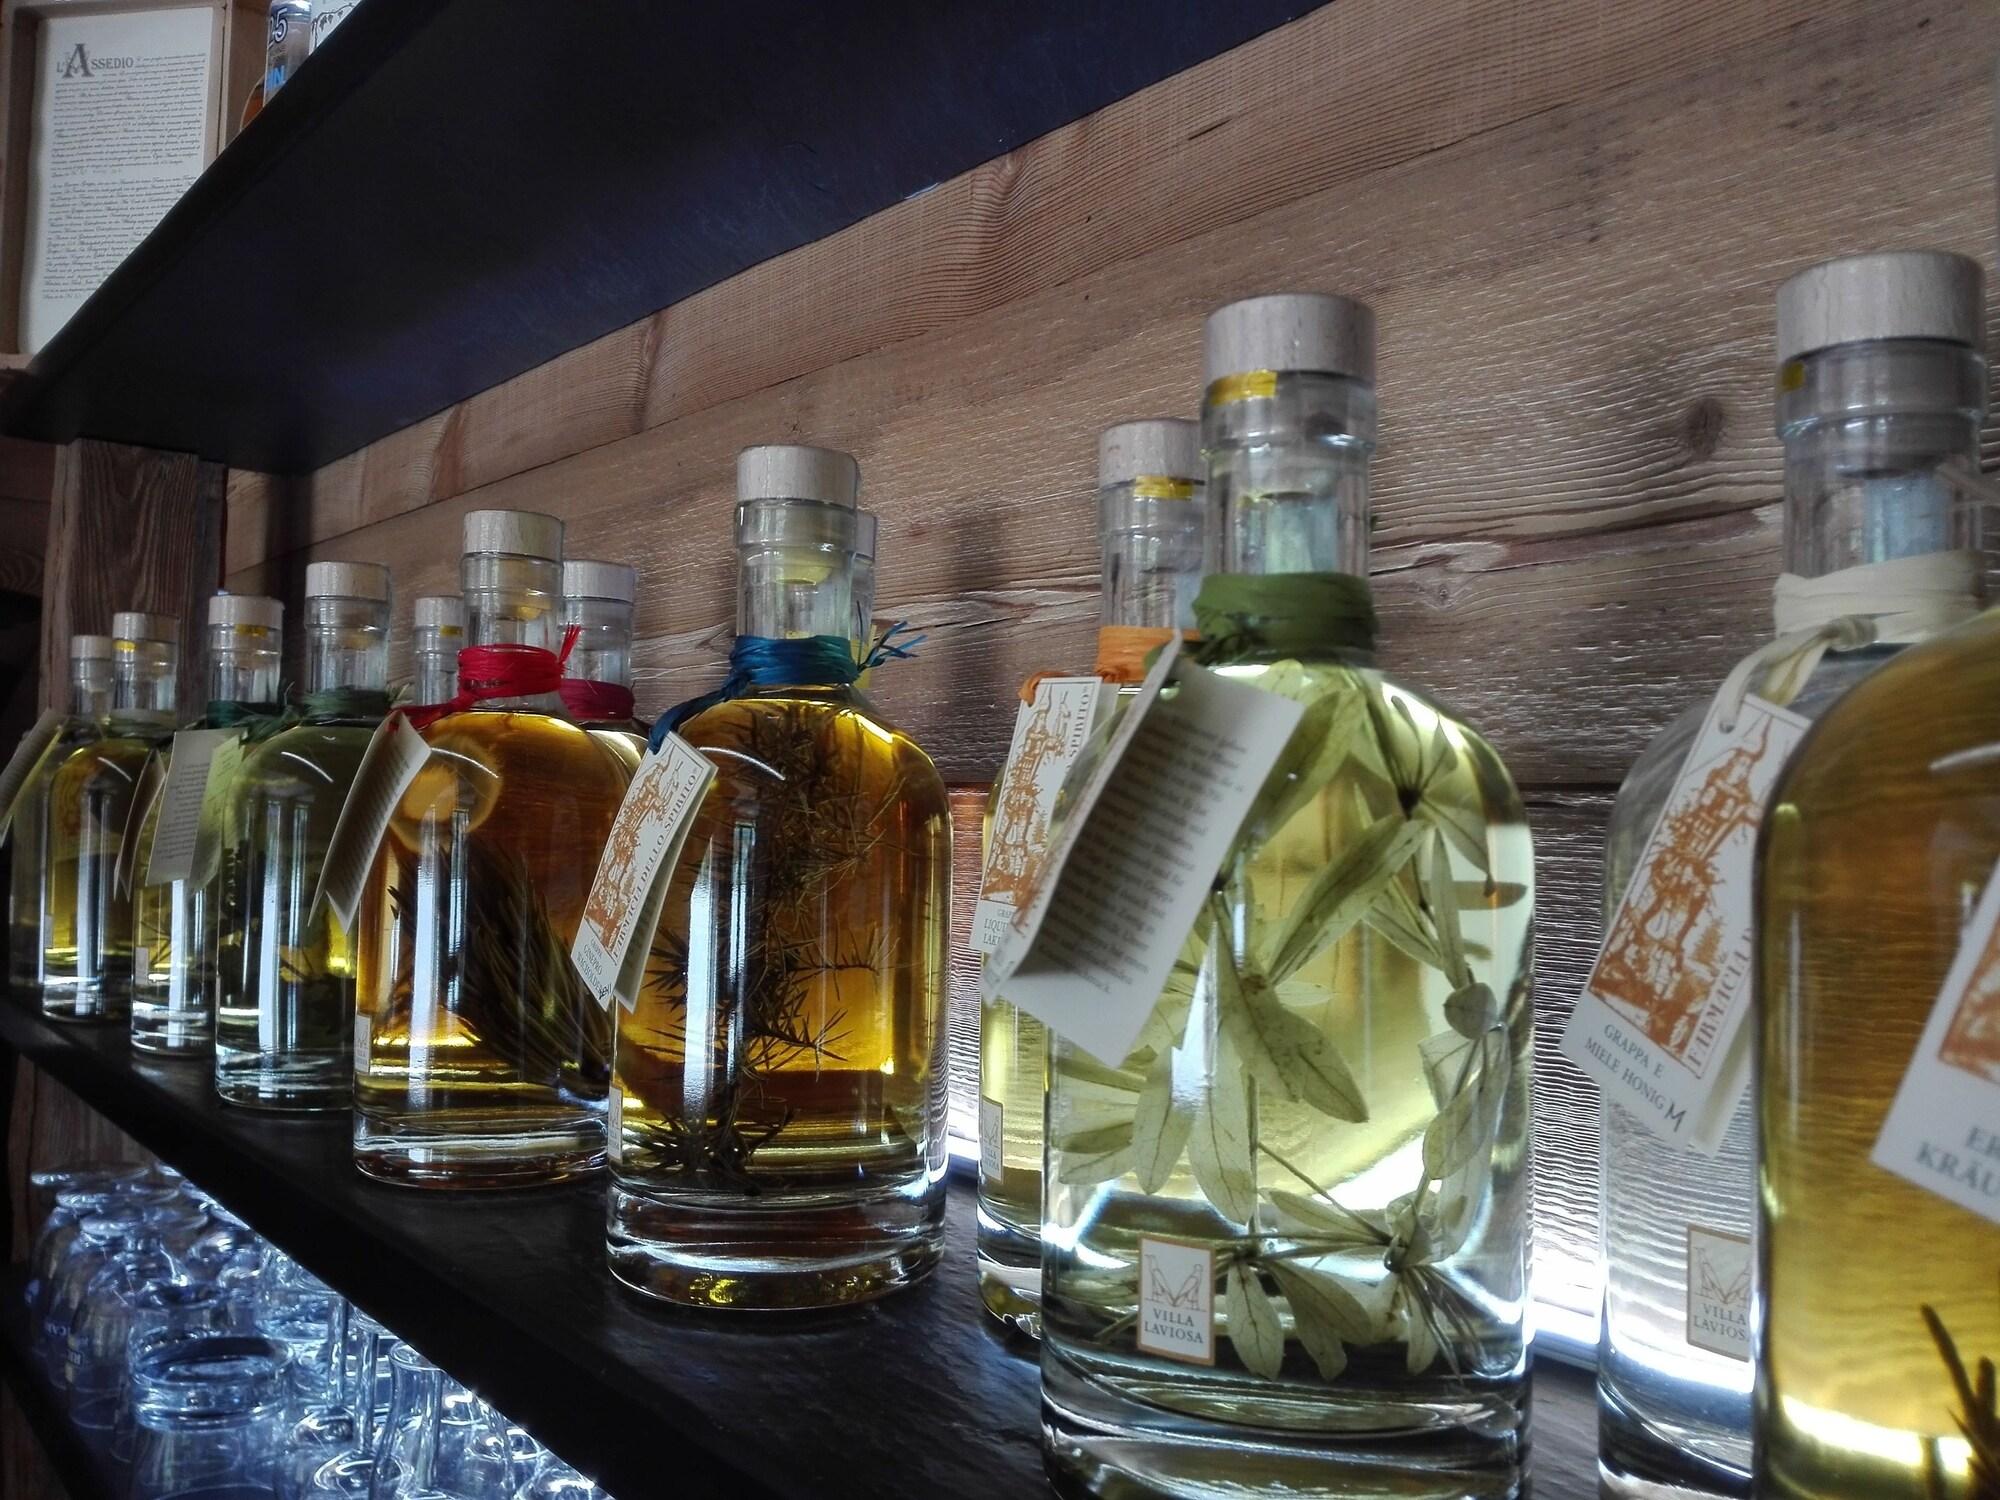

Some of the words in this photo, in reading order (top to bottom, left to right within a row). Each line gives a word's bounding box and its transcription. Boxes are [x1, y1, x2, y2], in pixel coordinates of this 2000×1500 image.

[665, 775, 696, 830] SPIRITO
[1604, 1024, 1650, 1068] GRAPPA
[1653, 1063, 1665, 1079] E
[1584, 1037, 1620, 1073] MIELE
[1621, 1067, 1664, 1110] HONIG
[1153, 1307, 1195, 1328] VILLA
[1693, 1315, 1748, 1343] LAVIOS
[1703, 1303, 1747, 1327] VILLA
[1144, 1321, 1204, 1345] LAVIOSA
